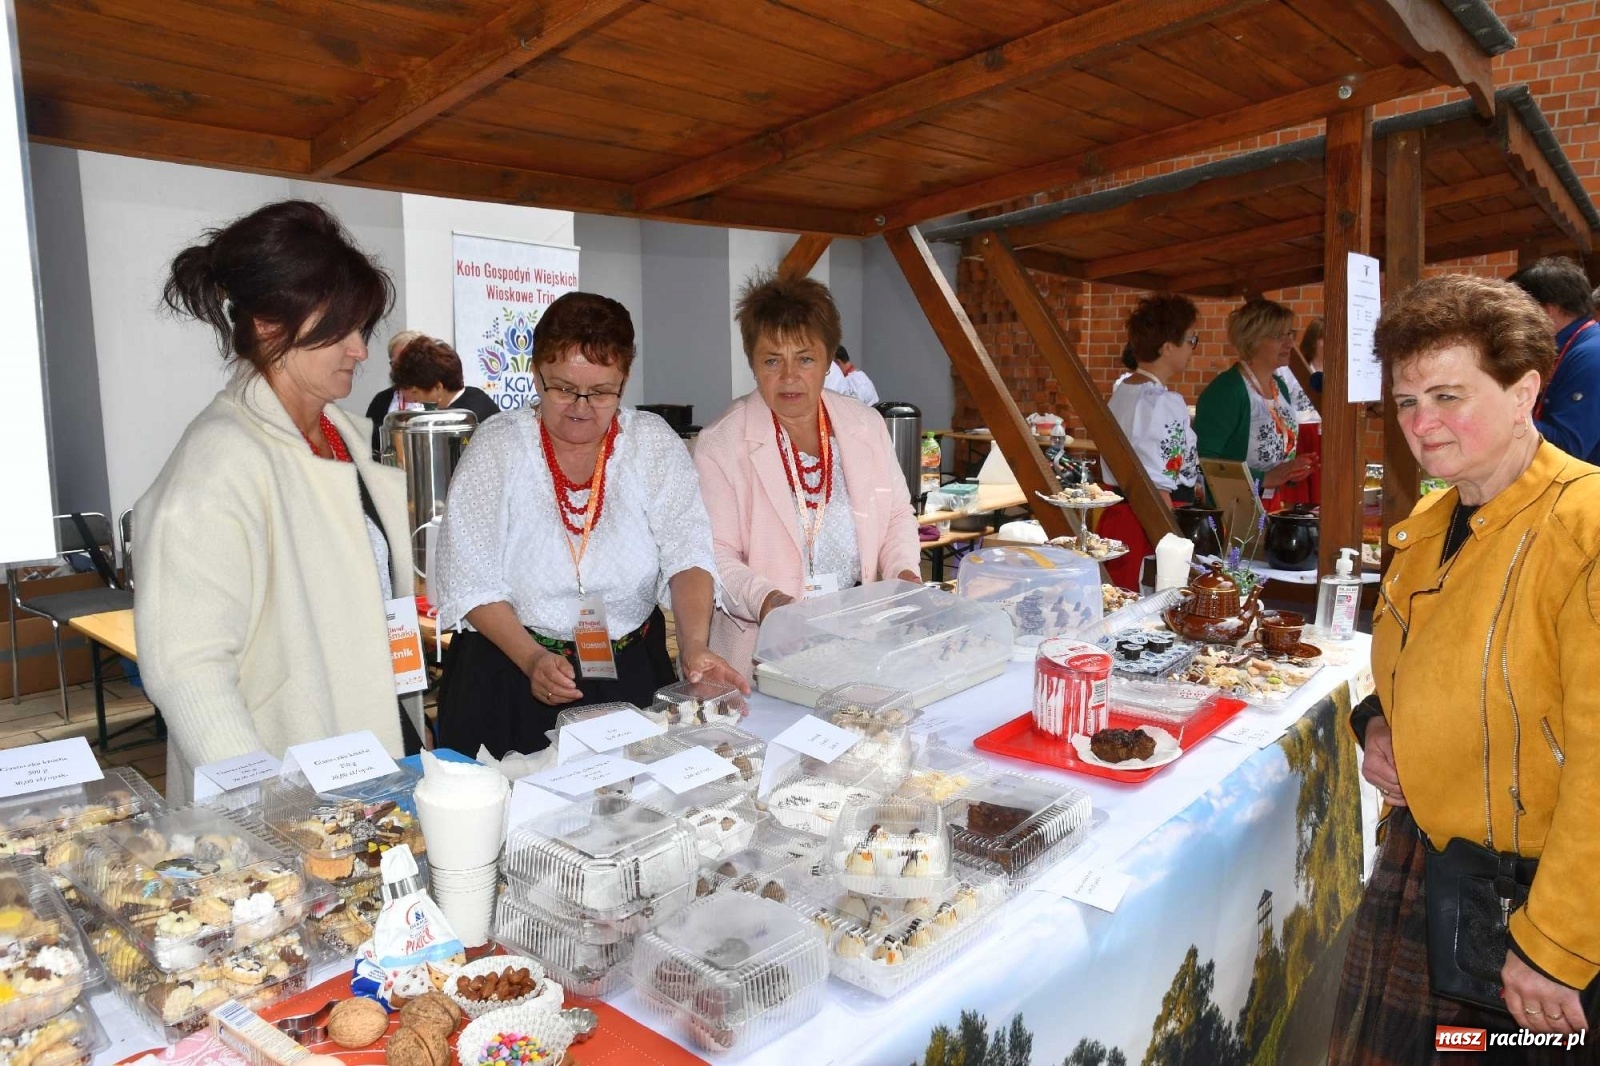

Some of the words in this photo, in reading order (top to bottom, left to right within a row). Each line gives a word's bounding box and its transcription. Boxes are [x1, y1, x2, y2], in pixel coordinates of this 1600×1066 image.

[456, 259, 481, 277] Koło
[484, 262, 531, 284] Gospodyń
[533, 268, 577, 287] Wiejskich
[485, 284, 534, 304] Wioskowe
